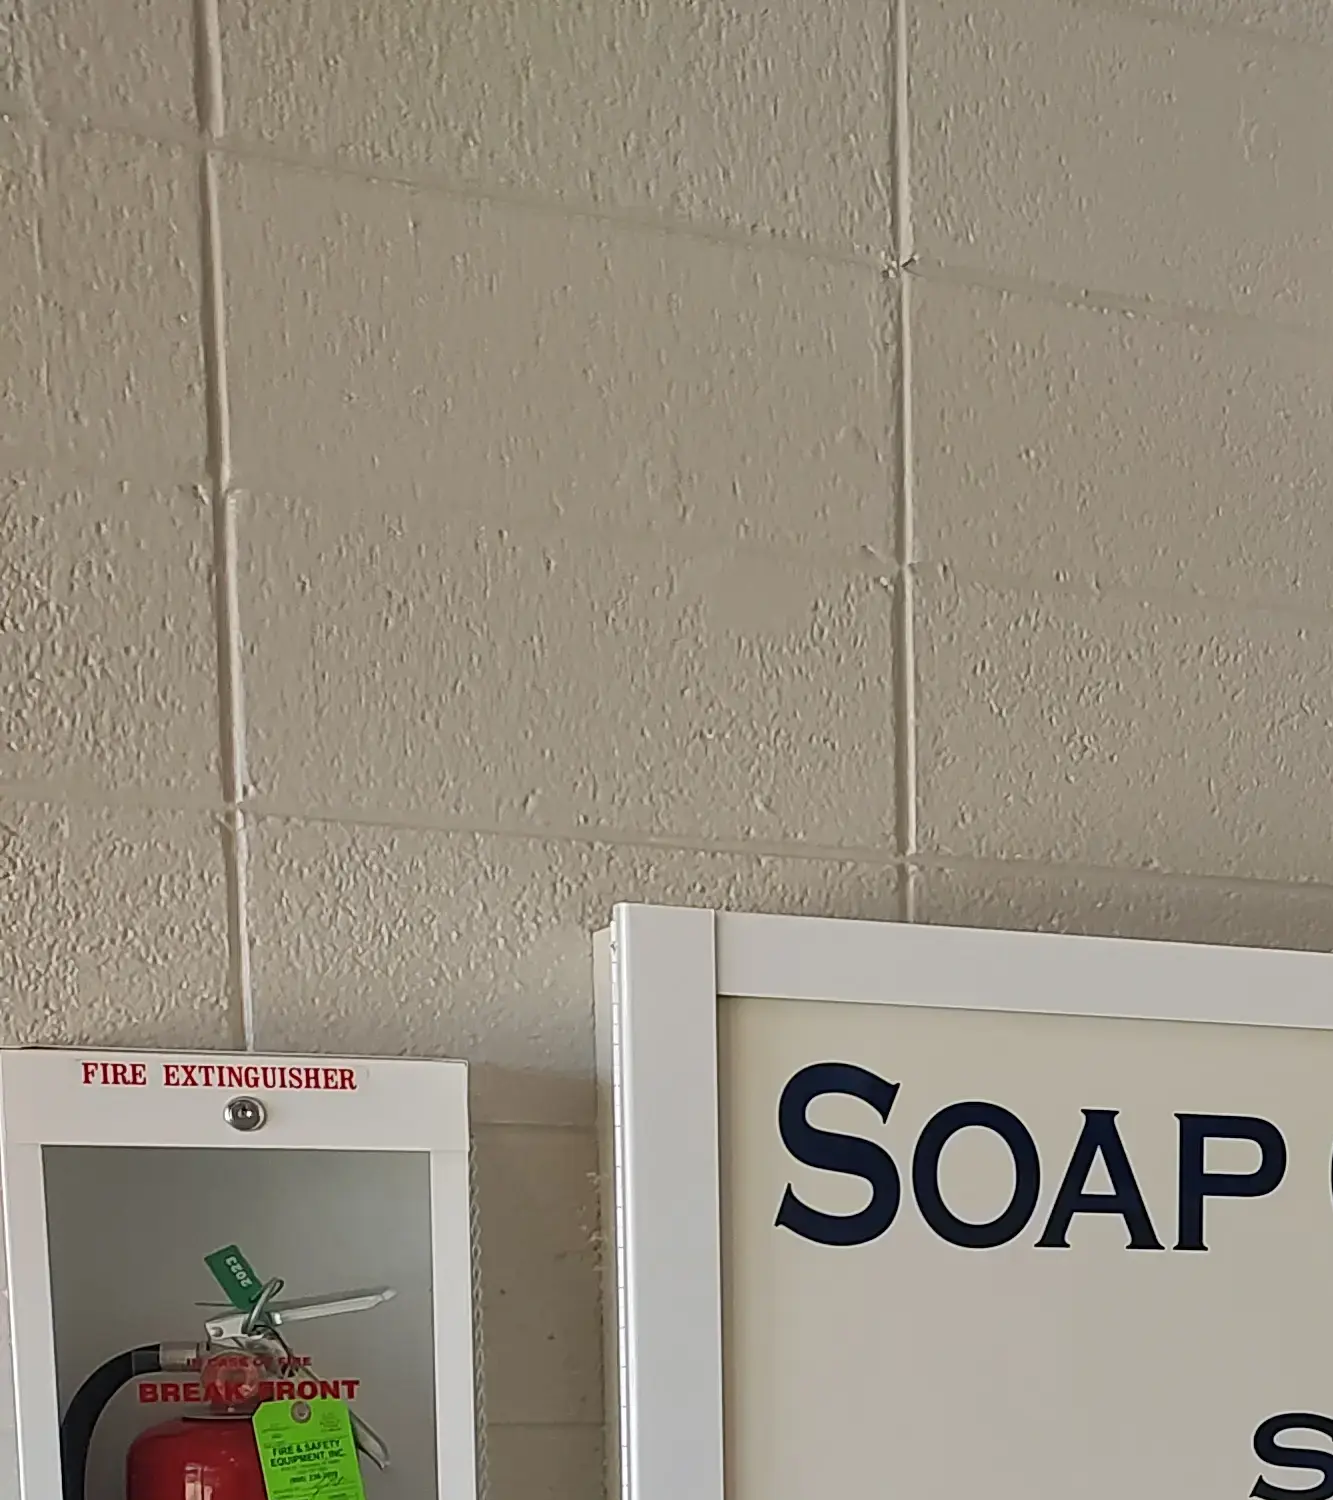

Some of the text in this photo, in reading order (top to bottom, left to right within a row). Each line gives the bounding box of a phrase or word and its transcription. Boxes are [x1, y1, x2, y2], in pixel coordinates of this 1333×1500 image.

[82, 1063, 357, 1090] FIRE EXTINGUISHER
[775, 1061, 1287, 1251] SOAP
[225, 1256, 253, 1288] 2023
[139, 1380, 360, 1403] BREAK FRONT
